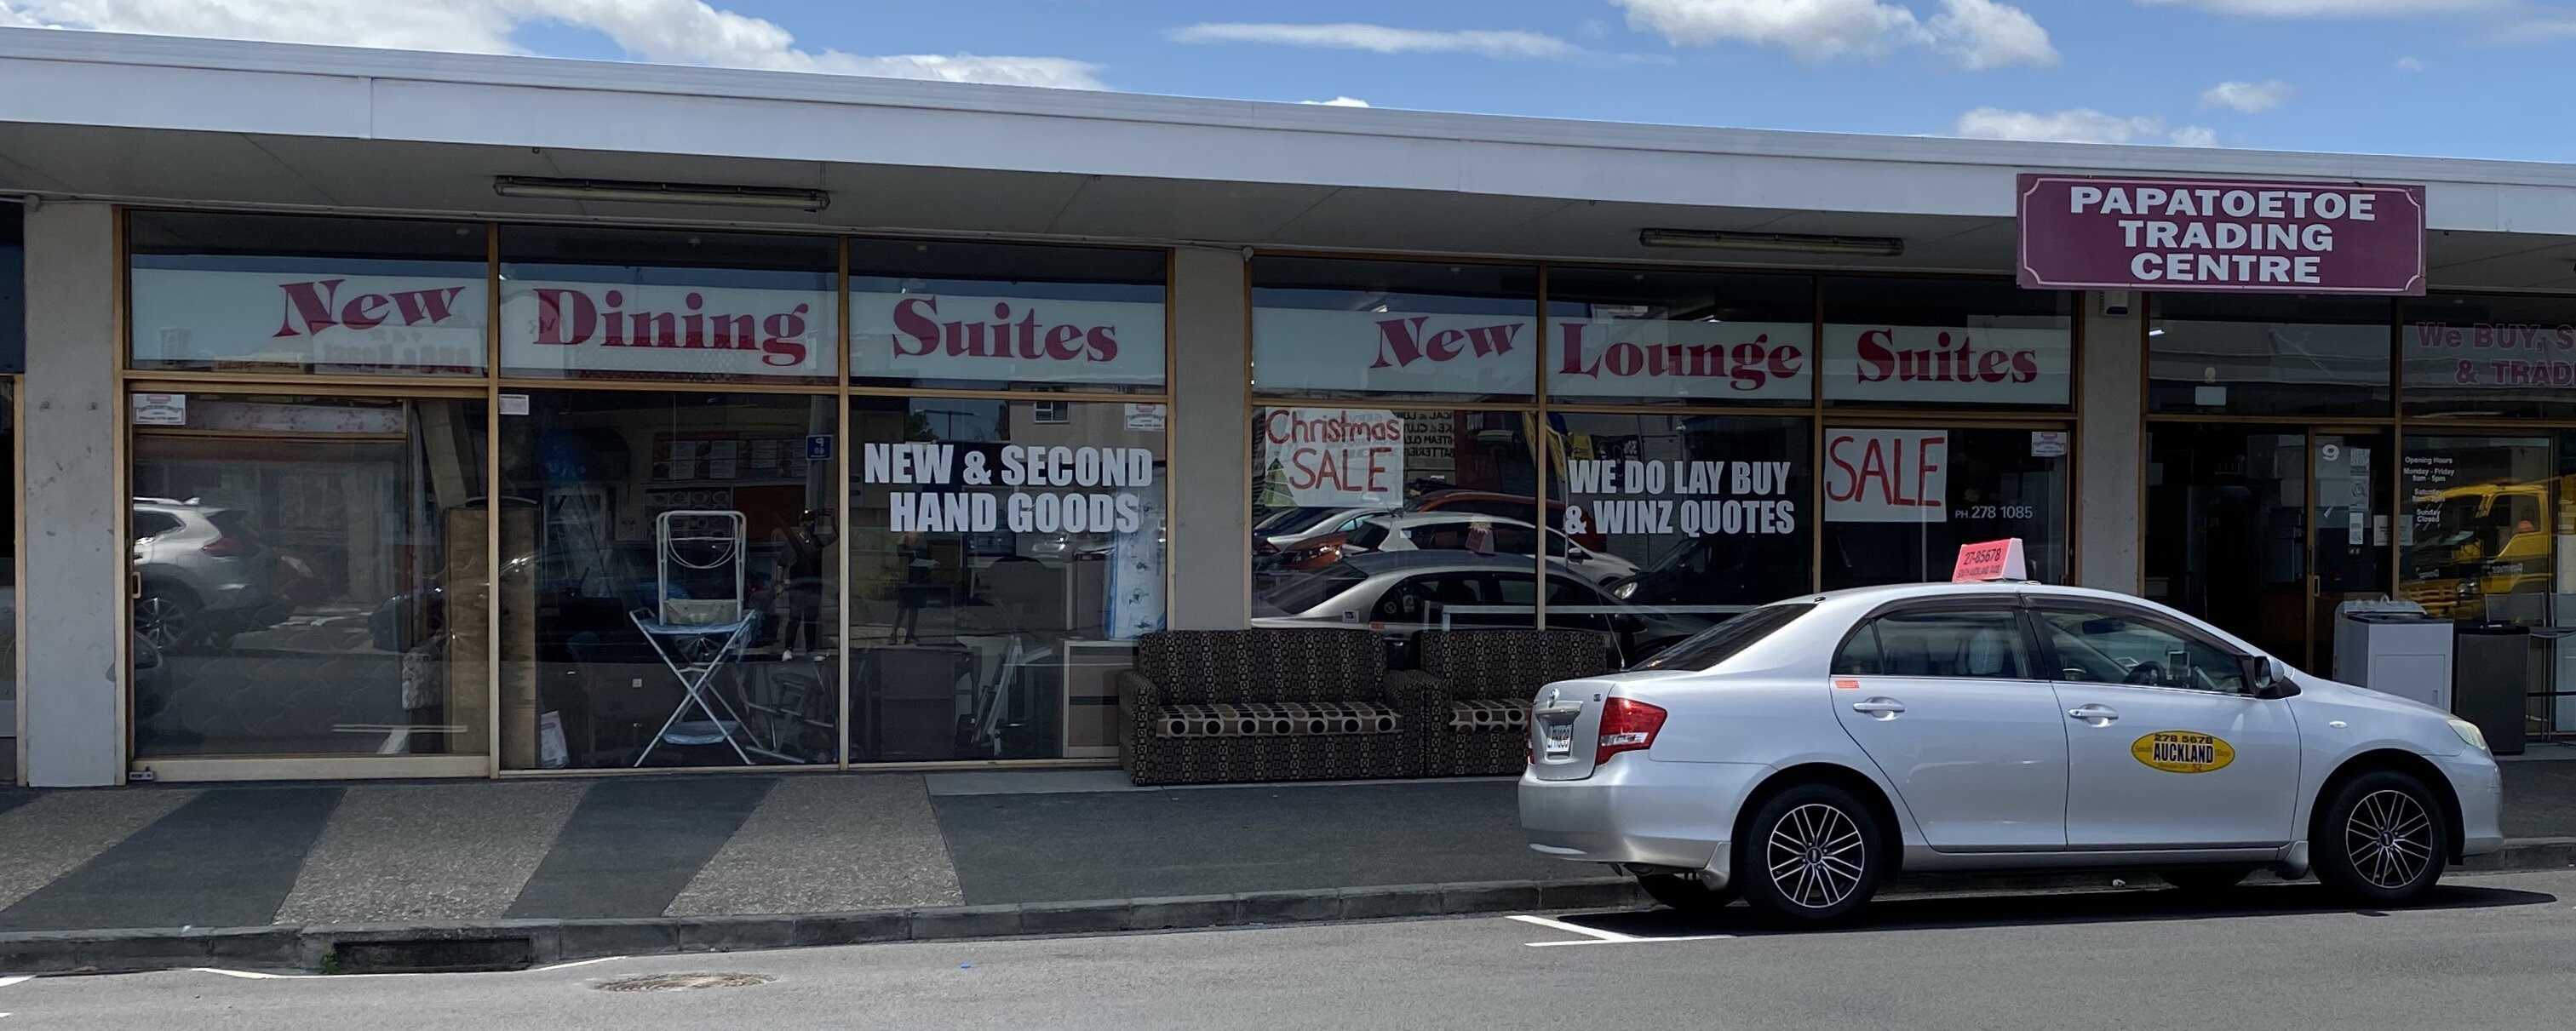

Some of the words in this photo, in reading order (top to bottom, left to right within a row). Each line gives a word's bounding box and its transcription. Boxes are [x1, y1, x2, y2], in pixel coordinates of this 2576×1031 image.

[2070, 186, 2376, 221] PAPATOETOE
[2118, 220, 2333, 251] TRADING
[2131, 252, 2321, 284] CENTRE
[273, 278, 466, 338] New
[533, 287, 811, 368] Dining
[892, 295, 1117, 364] Suites
[2415, 321, 2464, 349] We
[2555, 324, 2576, 352] S
[1370, 315, 1525, 369] New
[1558, 322, 1804, 392] Lounge
[1856, 327, 2038, 384] Suites
[2455, 358, 2481, 386] &
[2490, 359, 2576, 388] TRAD
[1264, 409, 1401, 447] Christmas
[864, 443, 955, 484] NEW
[963, 450, 991, 485] &
[1001, 444, 1153, 487] SECOND
[2322, 444, 2340, 461] 9
[2405, 456, 2432, 465] Opening
[1288, 446, 1392, 494] SALE
[1569, 460, 1617, 495] WE
[1625, 460, 1666, 495] DO
[1674, 461, 1725, 495] LAY
[1731, 461, 1791, 495] BUY
[1826, 435, 1946, 507] SALE
[2403, 467, 2429, 476] Monday
[2435, 468, 2454, 477] Friday
[890, 492, 997, 532] HAND
[1007, 492, 1140, 534] GOODS
[1564, 504, 1586, 536] &
[1593, 501, 1673, 535] WINZ
[1680, 500, 1795, 538] QUOTES
[1971, 506, 1997, 519] 278
[2000, 506, 2034, 519] 1085
[1964, 547, 2002, 565] 27-85678
[2153, 742, 2213, 764] AUCKLAND
[2154, 734, 2178, 742] 278
[2182, 736, 2213, 745] 5678
